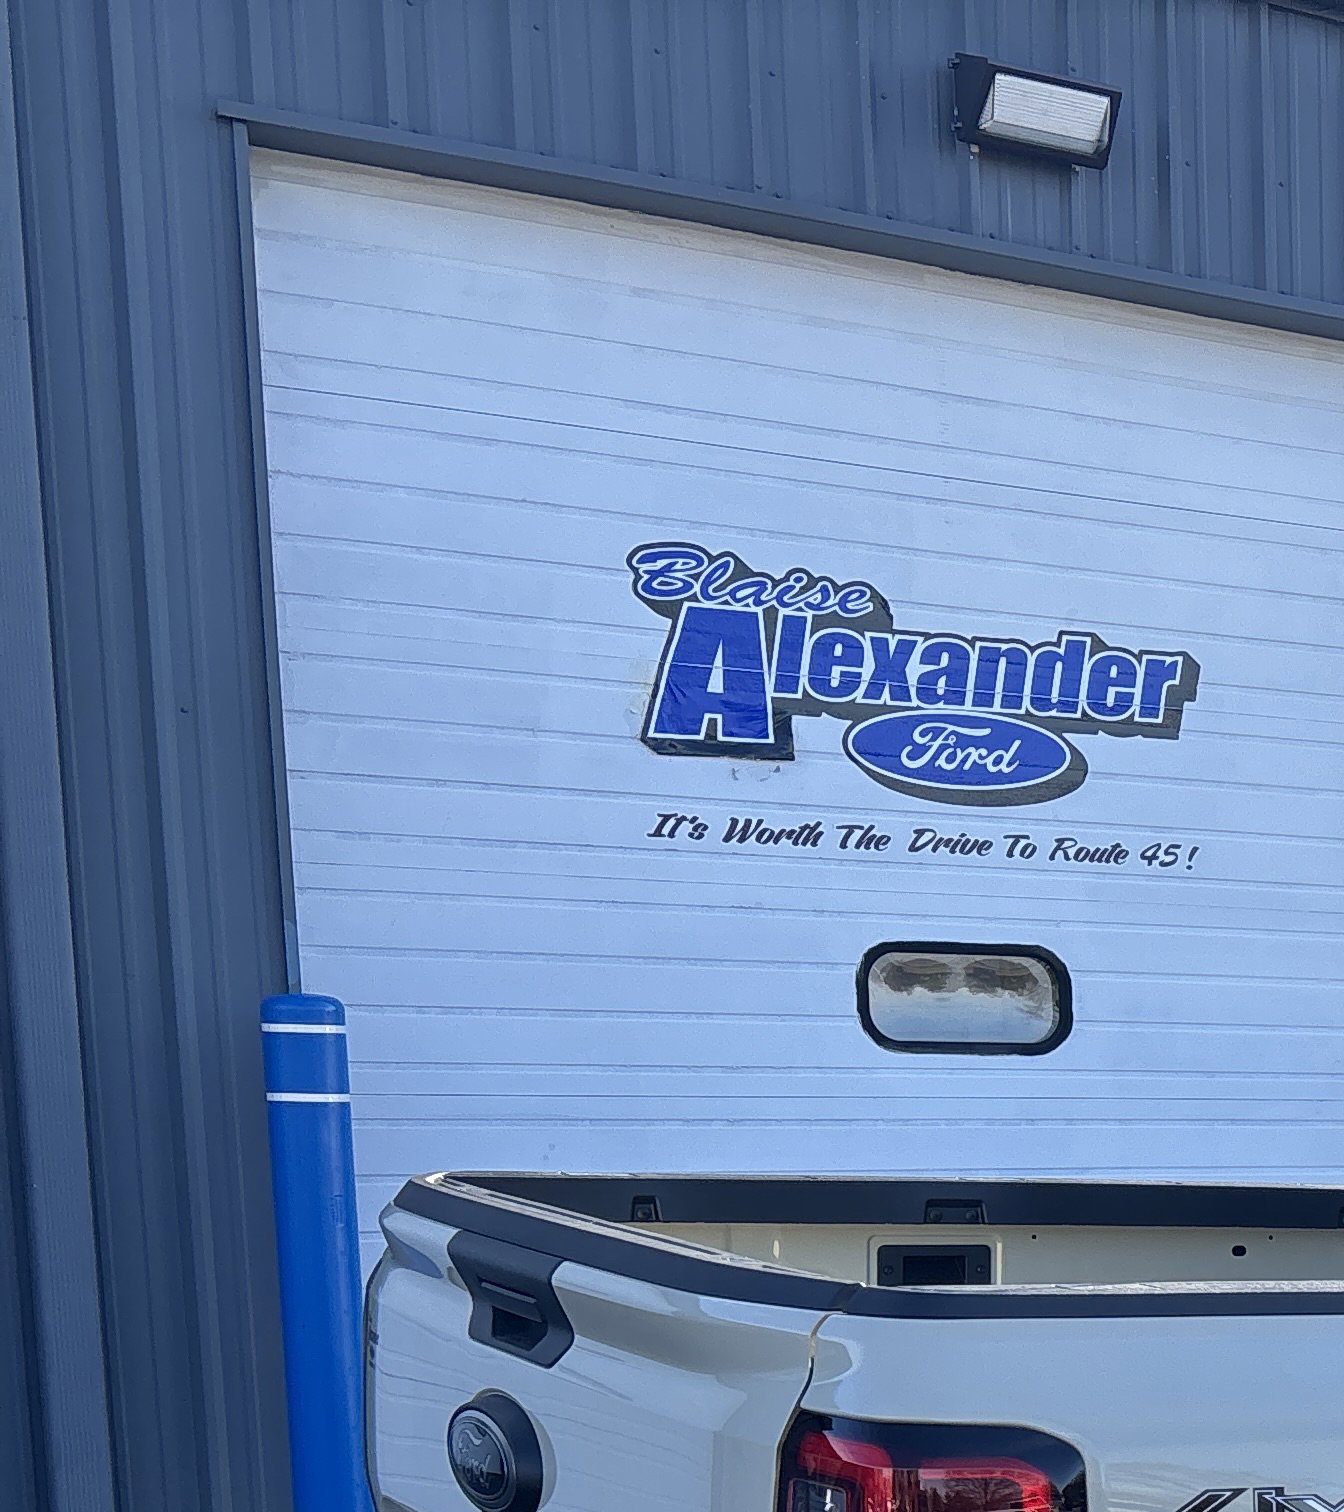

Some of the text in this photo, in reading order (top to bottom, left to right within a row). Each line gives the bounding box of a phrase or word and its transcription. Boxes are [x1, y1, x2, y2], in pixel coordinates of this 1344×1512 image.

[636, 545, 873, 617] Blaise
[648, 601, 1185, 744] Alexander
[900, 722, 1021, 775] Ford
[647, 812, 709, 840] It's
[722, 816, 825, 848] Worth
[836, 824, 892, 851] The
[908, 828, 993, 856] Drive
[1003, 834, 1037, 859] To
[1049, 837, 1130, 865] Route
